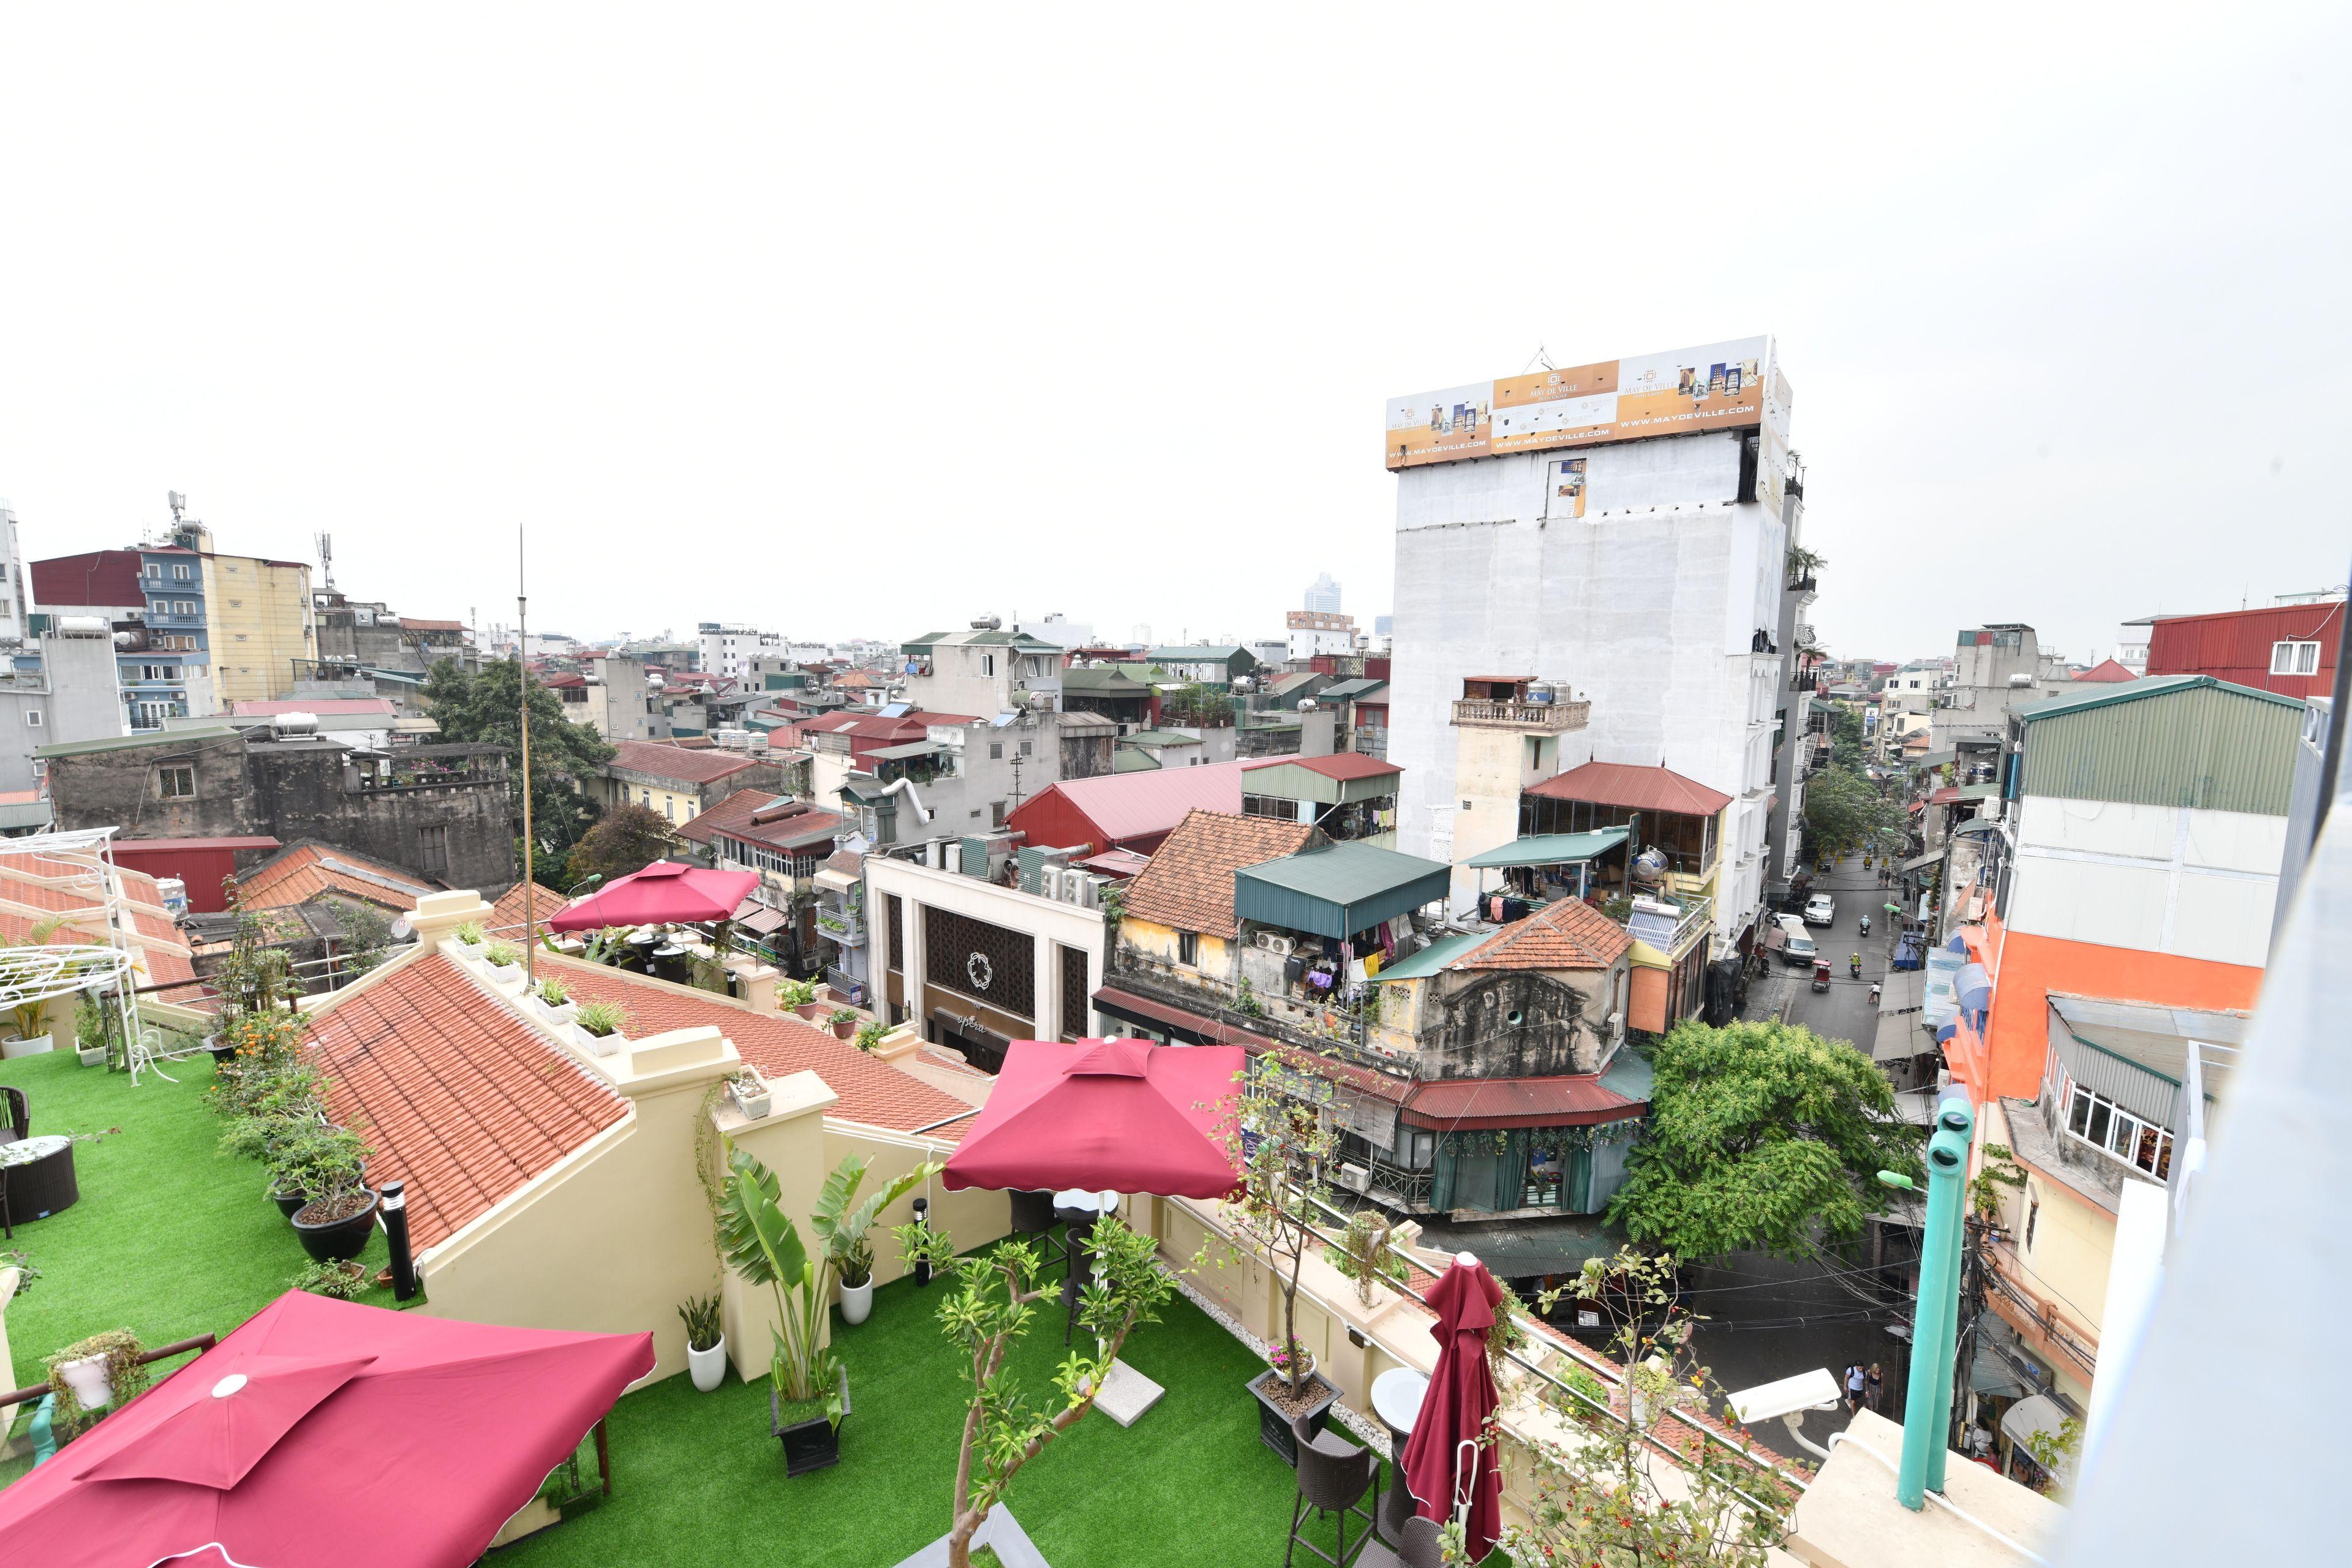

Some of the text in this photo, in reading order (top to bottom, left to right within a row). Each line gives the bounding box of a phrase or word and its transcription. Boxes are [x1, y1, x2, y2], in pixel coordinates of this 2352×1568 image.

[1530, 389, 1545, 398] MAY
[1558, 384, 1578, 393] VILLE
[1655, 381, 1675, 390] VILLE
[1621, 405, 1754, 428] WWW.MAYDEVILLE.COM
[1496, 429, 1609, 448] WWW.MAYDEVILLE.COM
[1389, 440, 1486, 458] WWW.MAYDEVILLE.COM
